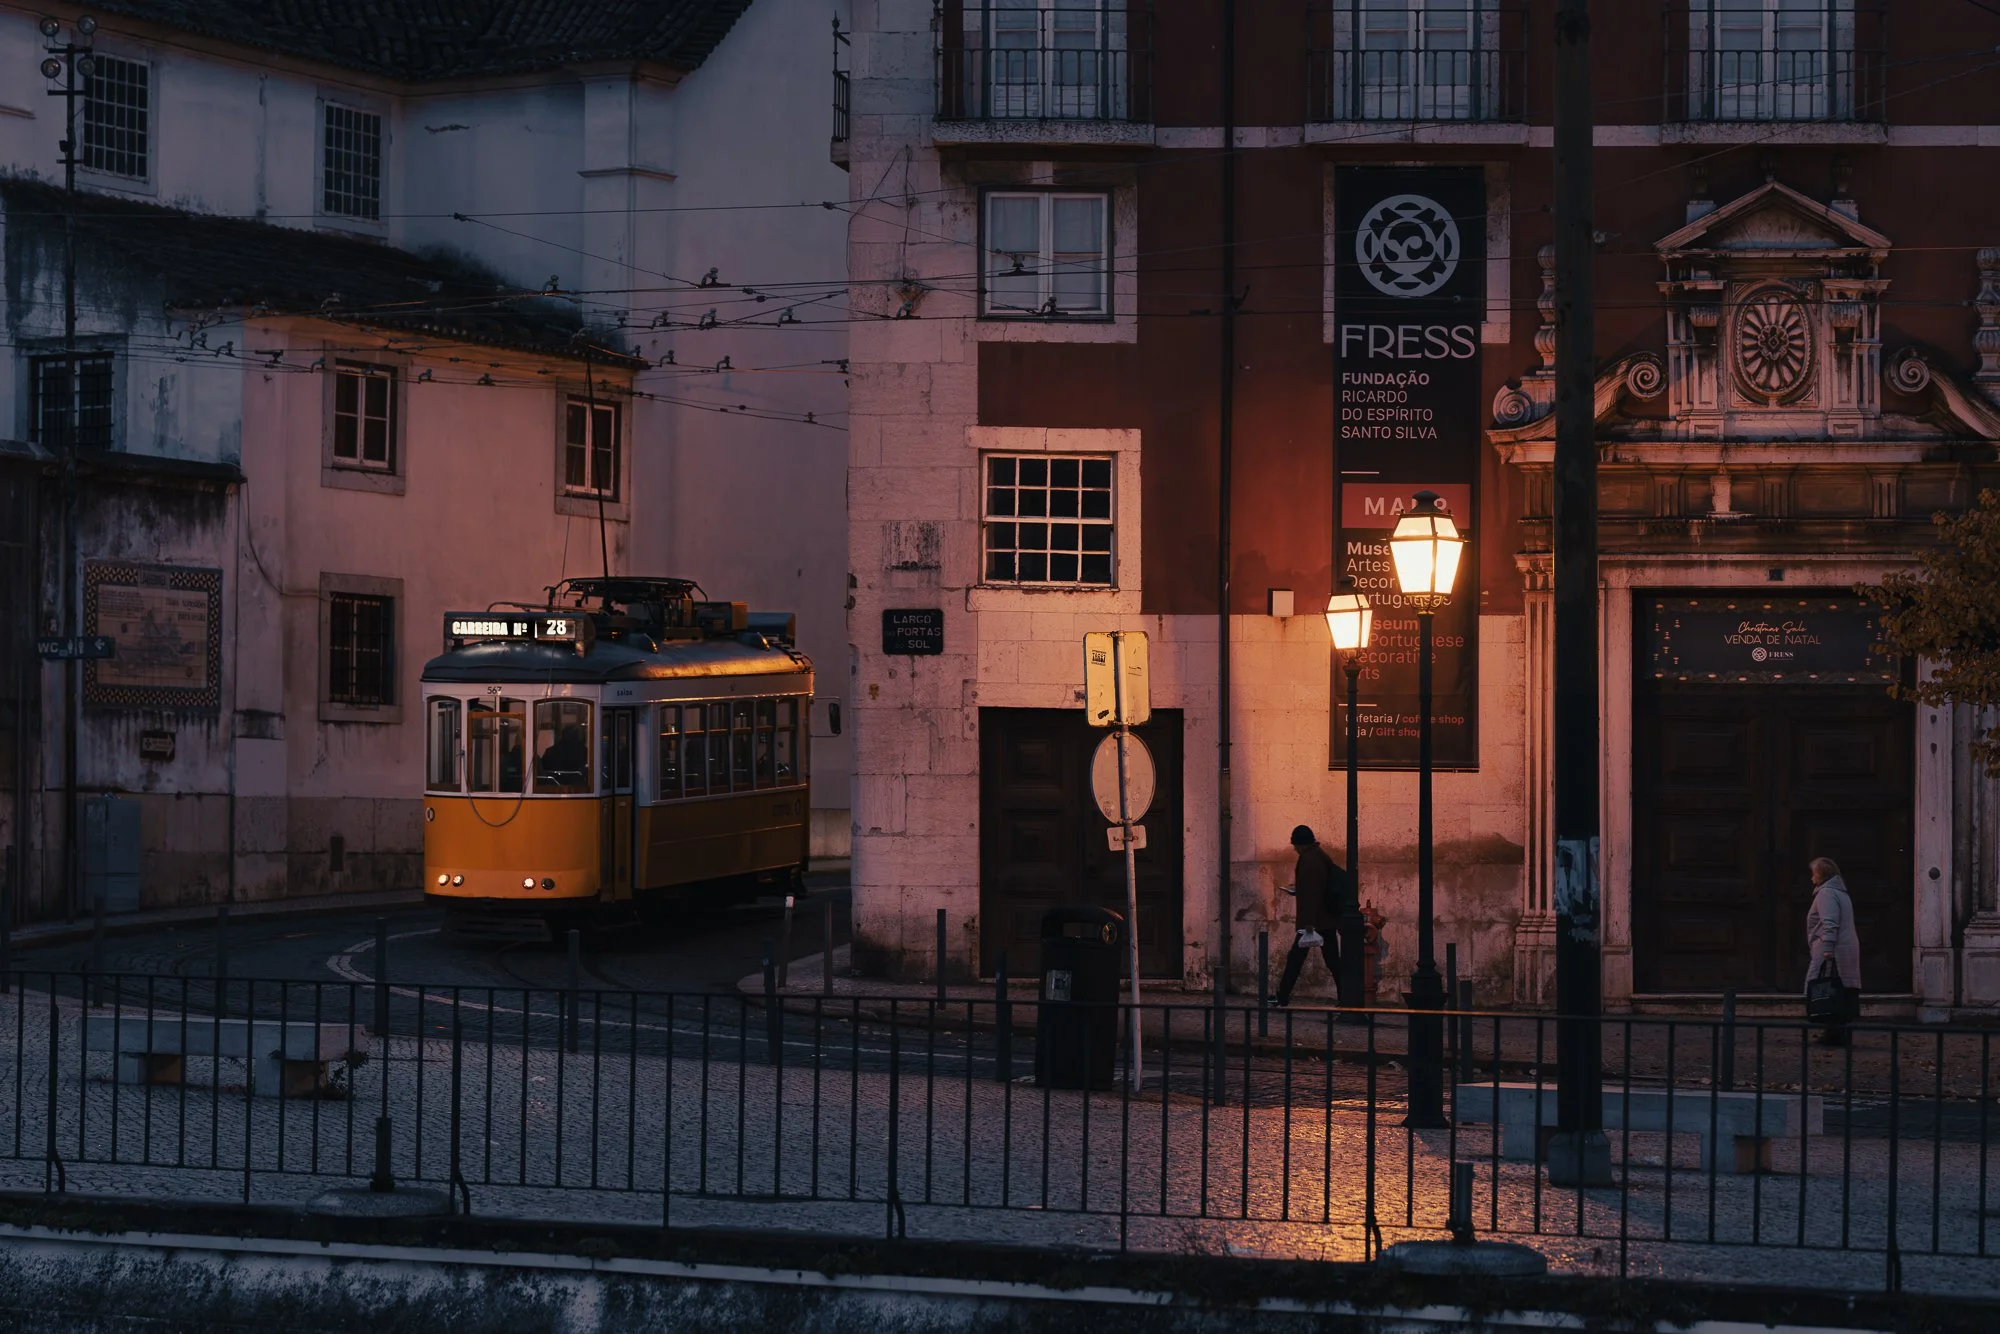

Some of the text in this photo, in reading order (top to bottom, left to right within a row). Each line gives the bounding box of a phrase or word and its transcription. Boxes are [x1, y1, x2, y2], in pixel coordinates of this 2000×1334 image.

[1341, 324, 1476, 359] FRESS
[1342, 370, 1430, 388] FUNDAÇÃO
[1342, 390, 1408, 403] RICARDO
[1342, 405, 1433, 421] DO ESPÍRITO
[1341, 426, 1437, 439] SANTO SILVA
[1346, 558, 1391, 573] Artes
[893, 615, 932, 624] LARGO
[452, 621, 509, 636] CARREIRA
[546, 619, 567, 635] 28
[897, 627, 942, 637] PORTAS
[1738, 620, 1807, 635] Christmas Sale
[907, 639, 931, 649] SOL
[1724, 634, 1821, 645] VENDA DE NATAL
[37, 642, 59, 654] WC
[1357, 649, 1437, 664] ecoratie
[1357, 667, 1381, 680] rts
[1438, 714, 1465, 726] shop
[1345, 726, 1367, 738] Lja
[1375, 726, 1396, 737] Gift
